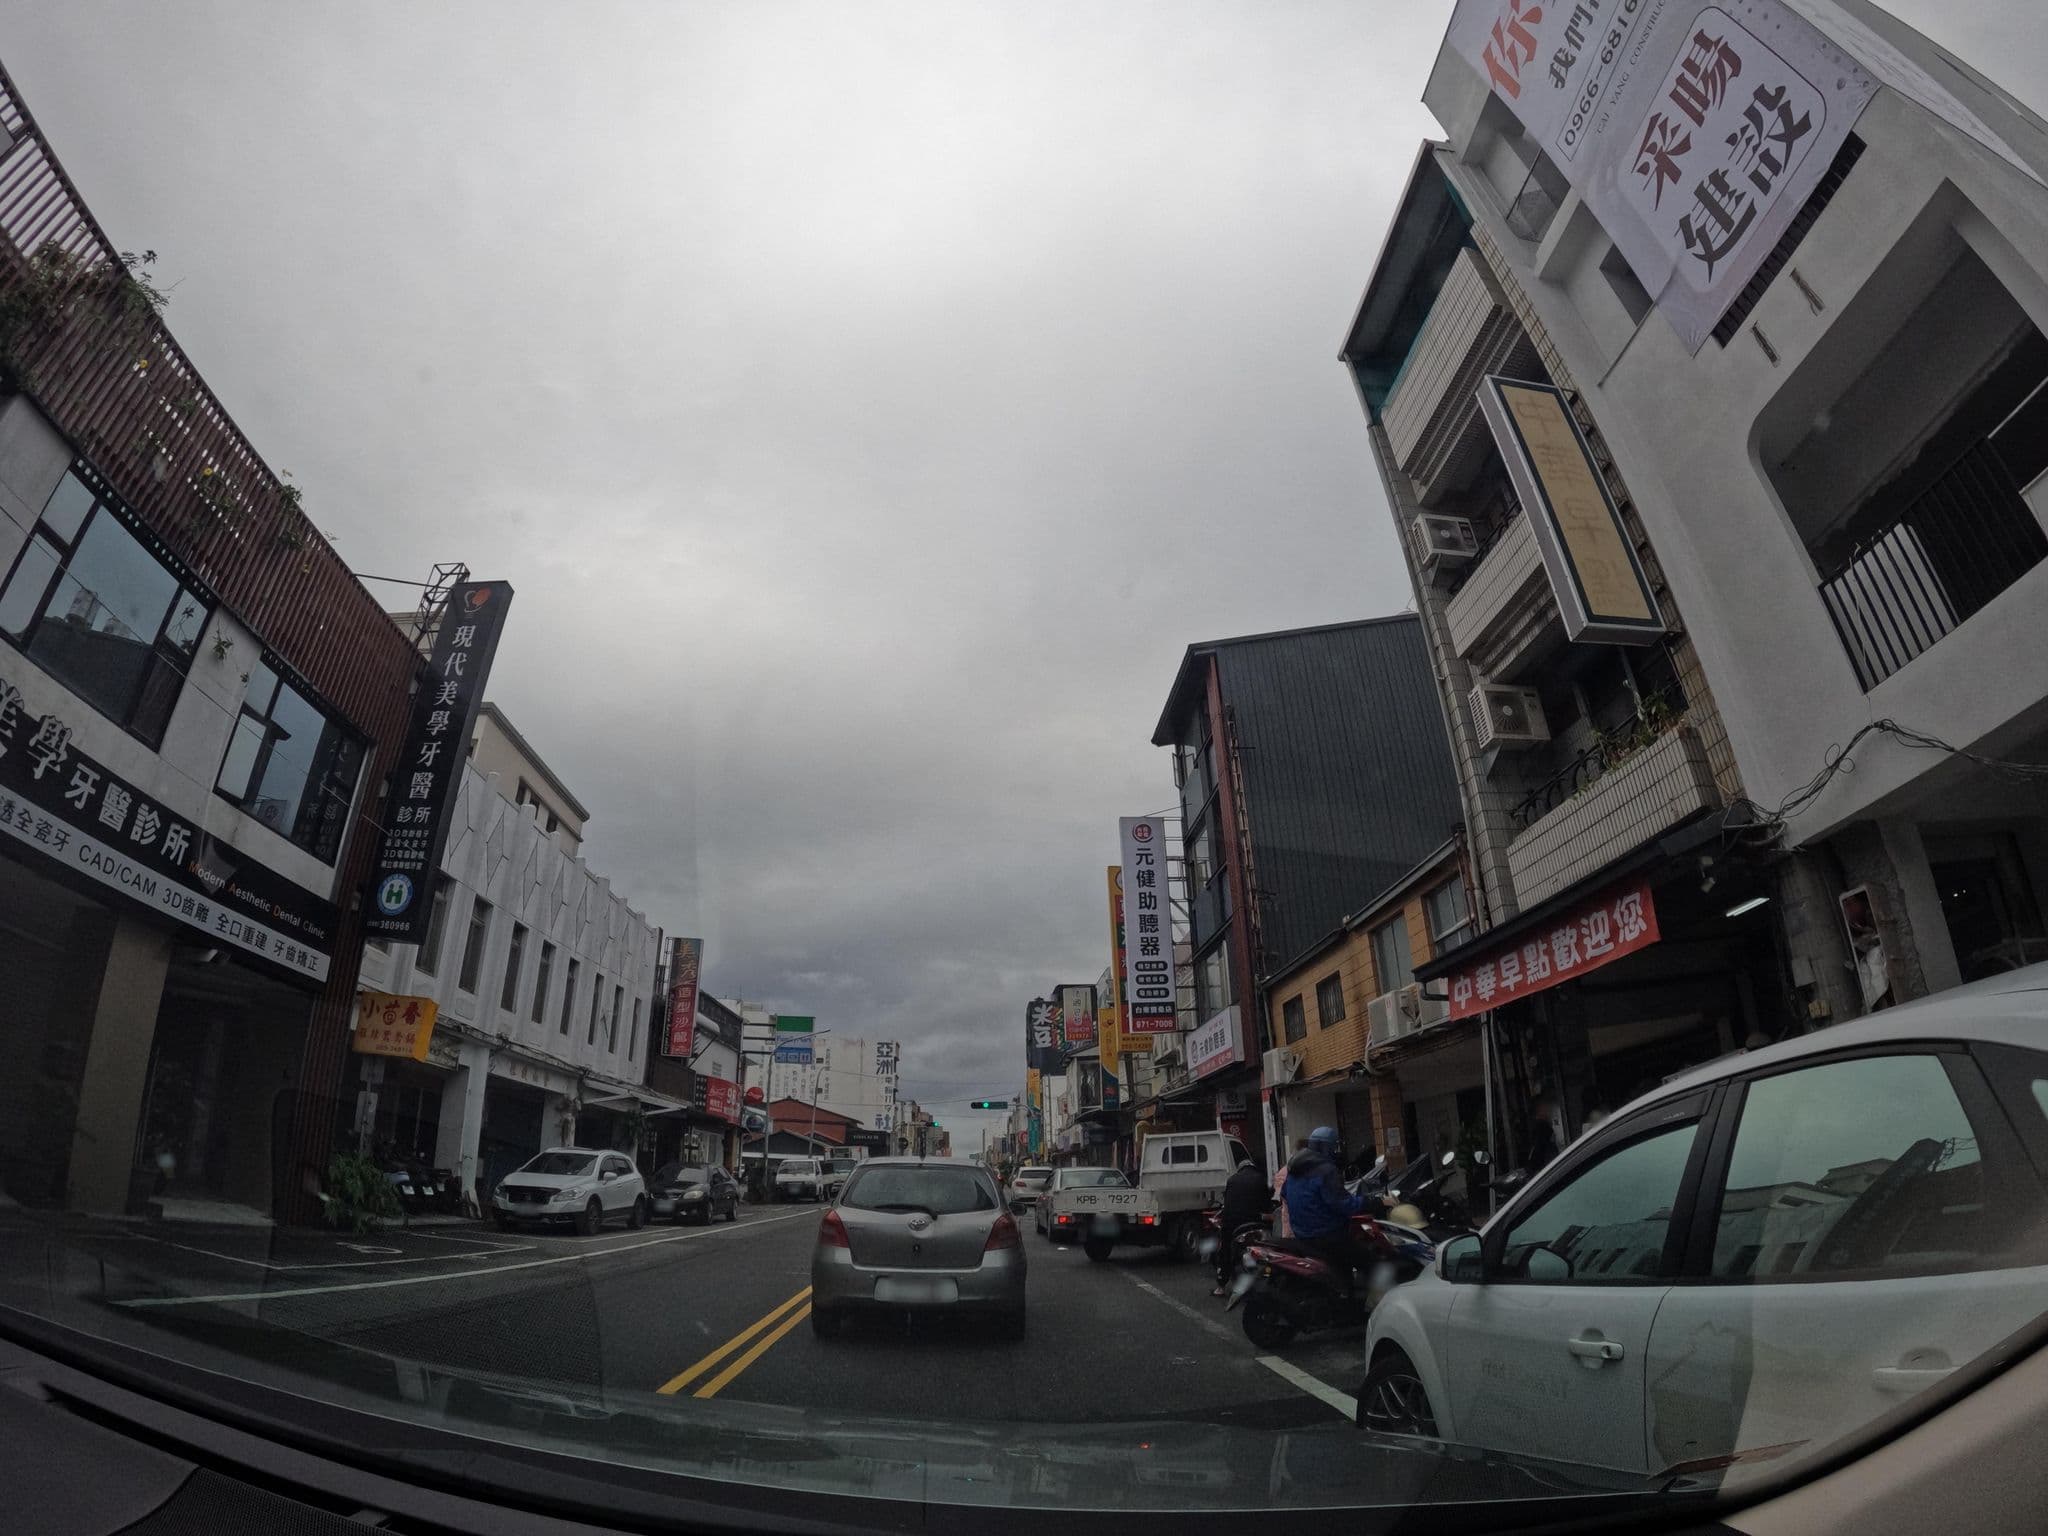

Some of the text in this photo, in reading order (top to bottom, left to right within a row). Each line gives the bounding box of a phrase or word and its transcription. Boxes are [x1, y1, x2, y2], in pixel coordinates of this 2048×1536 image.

[1549, 0, 1602, 89] 我們
[1674, 82, 1813, 283] 建設
[408, 624, 476, 800] 現代美學牙醫
[396, 805, 432, 824] 診所
[78, 844, 158, 897] CAD/CAM
[215, 912, 269, 952] 全口重建
[188, 860, 325, 940] Modern Aesthetic Dental Clinic
[1135, 847, 1160, 957] 元健助聽器
[1453, 891, 1648, 1010] 中華早點歡迎您
[1108, 1194, 1138, 1204] 7927
